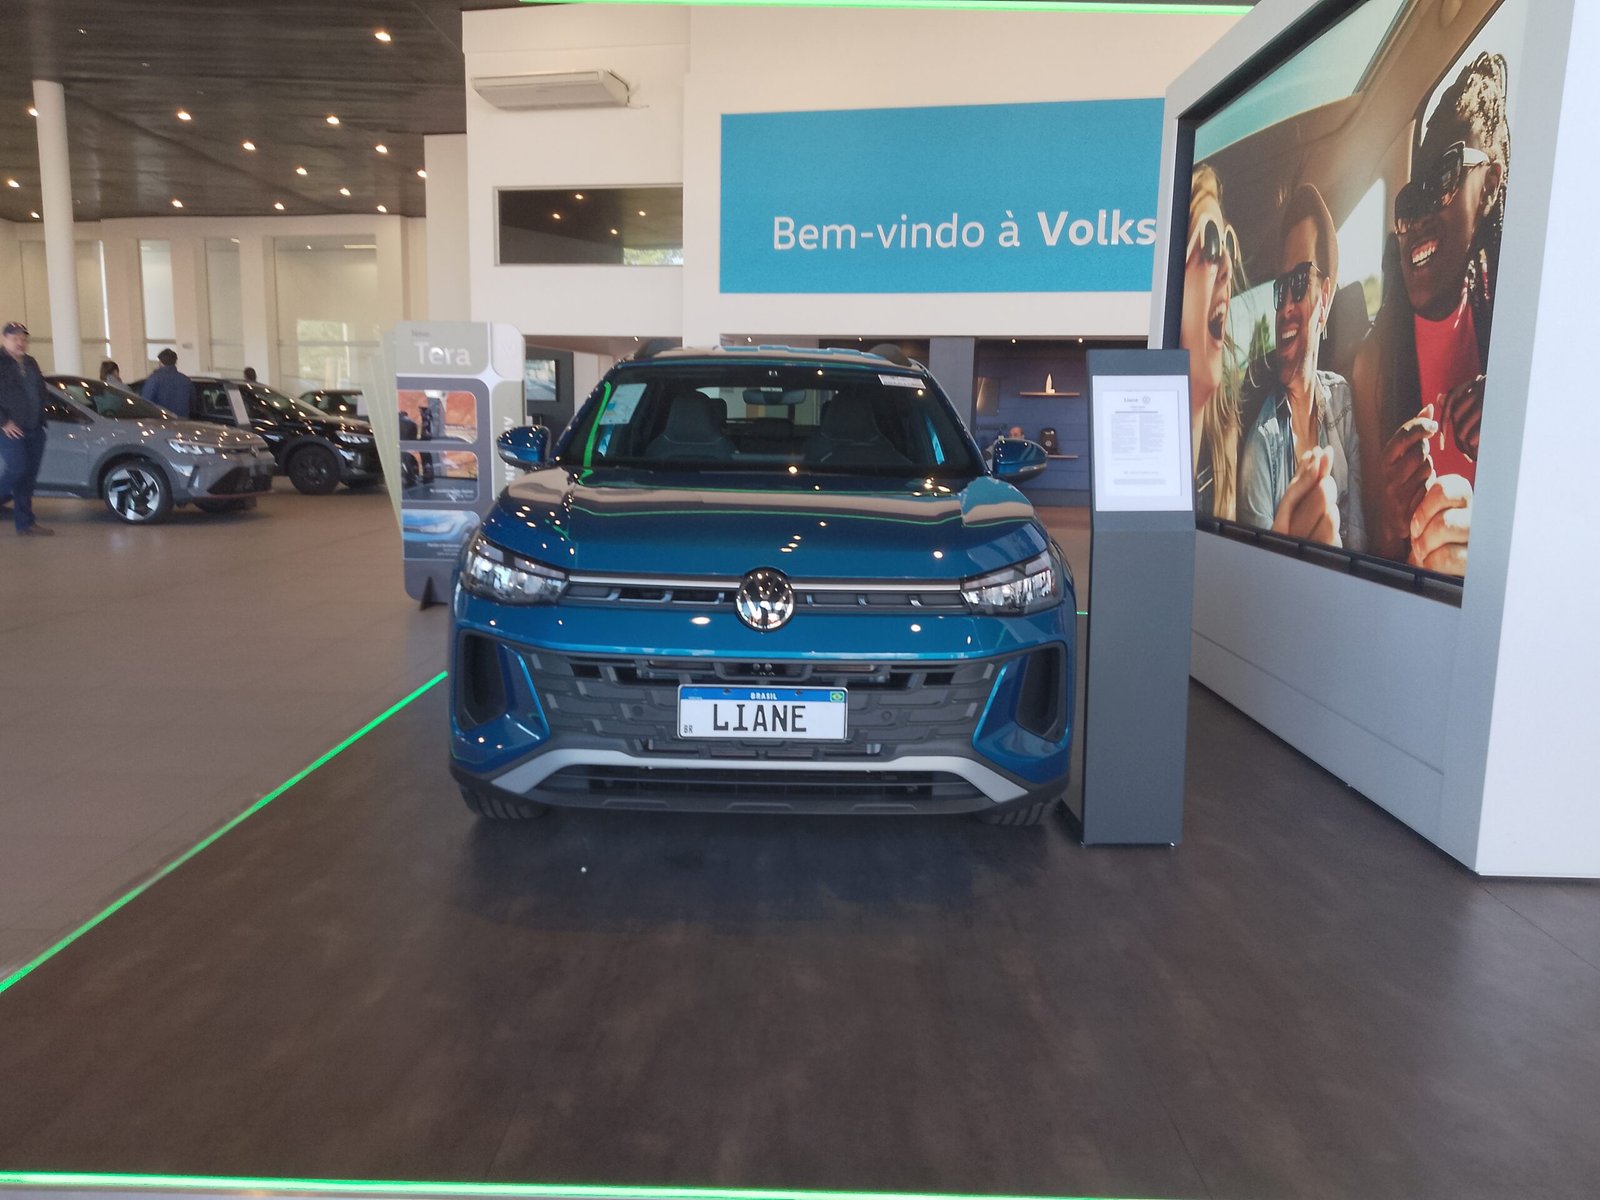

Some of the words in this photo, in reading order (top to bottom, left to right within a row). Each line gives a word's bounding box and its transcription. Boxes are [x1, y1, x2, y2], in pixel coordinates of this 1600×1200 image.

[773, 213, 985, 250] Bem-vindo
[998, 210, 1020, 247] à
[1037, 209, 1157, 246] Volks
[413, 341, 472, 367] Tera
[750, 692, 777, 700] BRASIL
[684, 725, 693, 734] BR
[713, 704, 807, 733] LIANE
